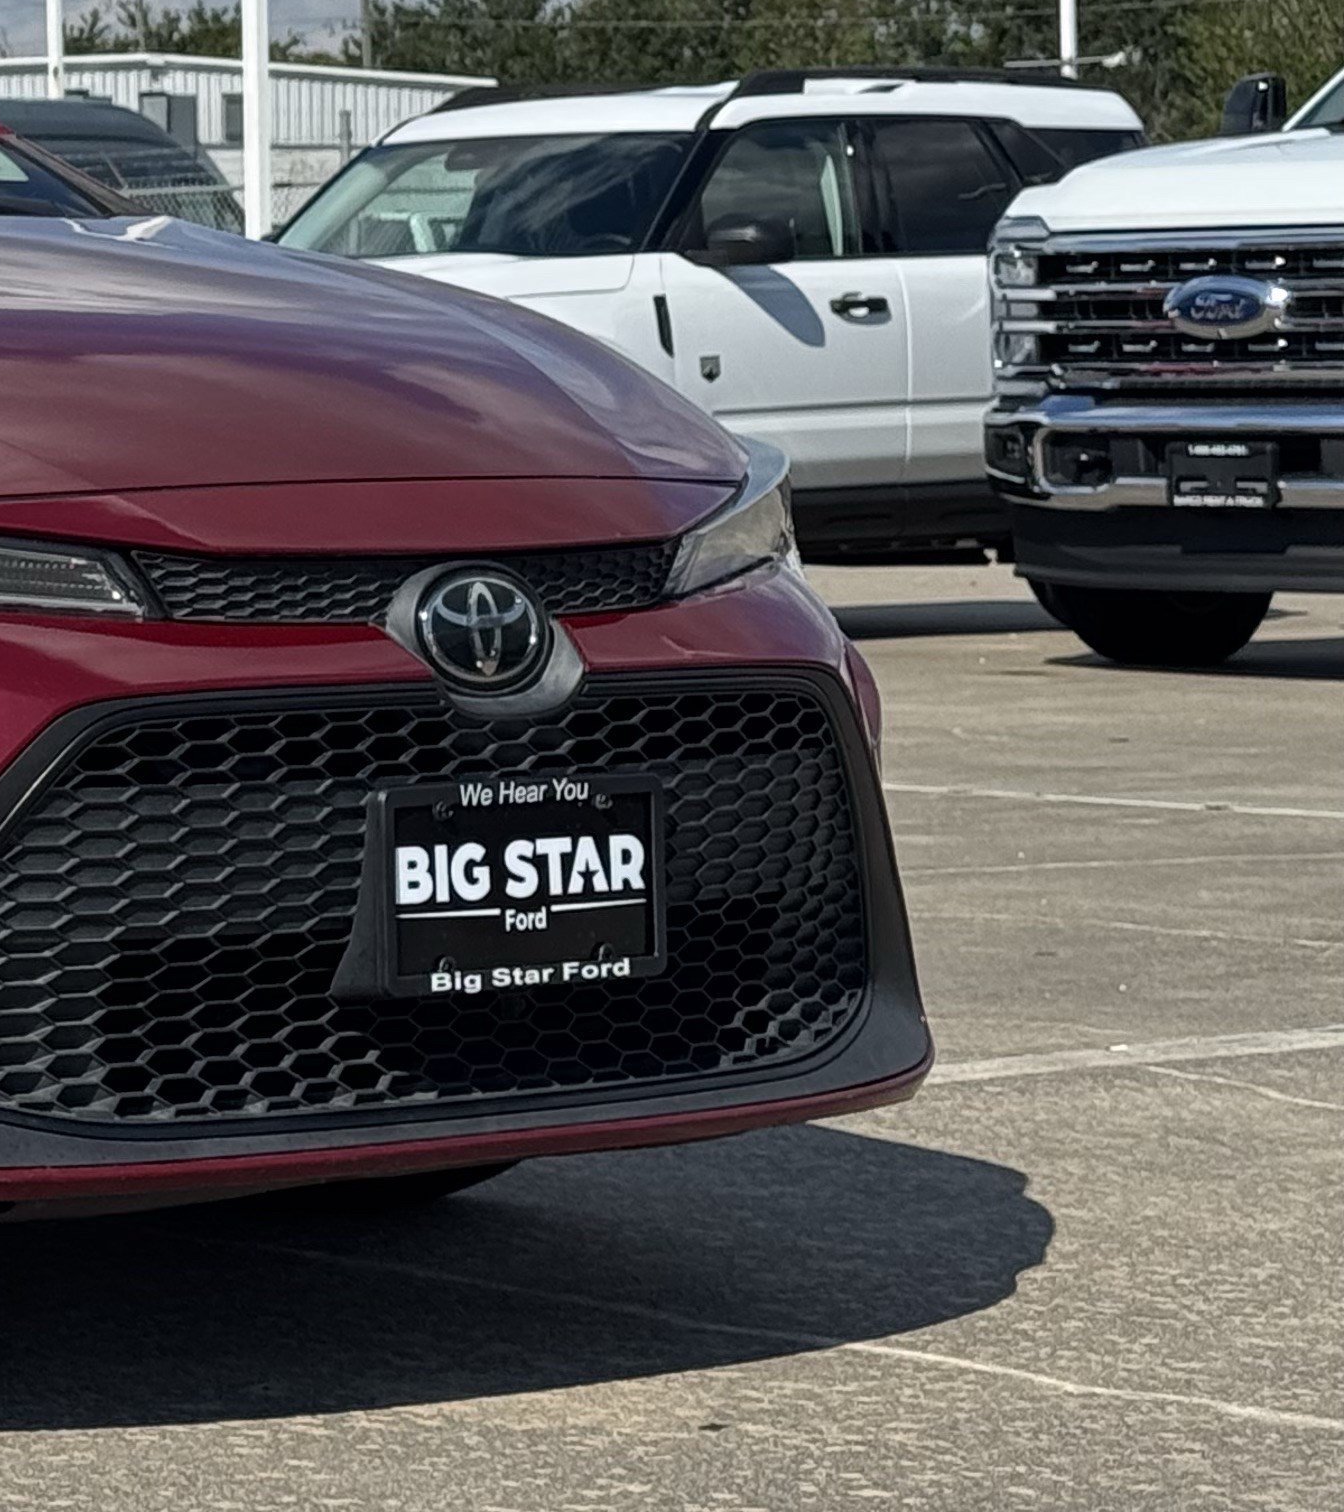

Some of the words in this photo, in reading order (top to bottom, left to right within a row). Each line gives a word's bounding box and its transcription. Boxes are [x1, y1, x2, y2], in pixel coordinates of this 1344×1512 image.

[459, 782, 493, 806] We
[498, 780, 549, 804] Hear
[552, 777, 589, 802] You
[395, 843, 492, 906] BIG
[503, 833, 646, 899] STAR
[505, 906, 548, 932] Ford
[430, 971, 482, 995] Big
[491, 962, 554, 988] Star
[562, 957, 631, 982] Ford
